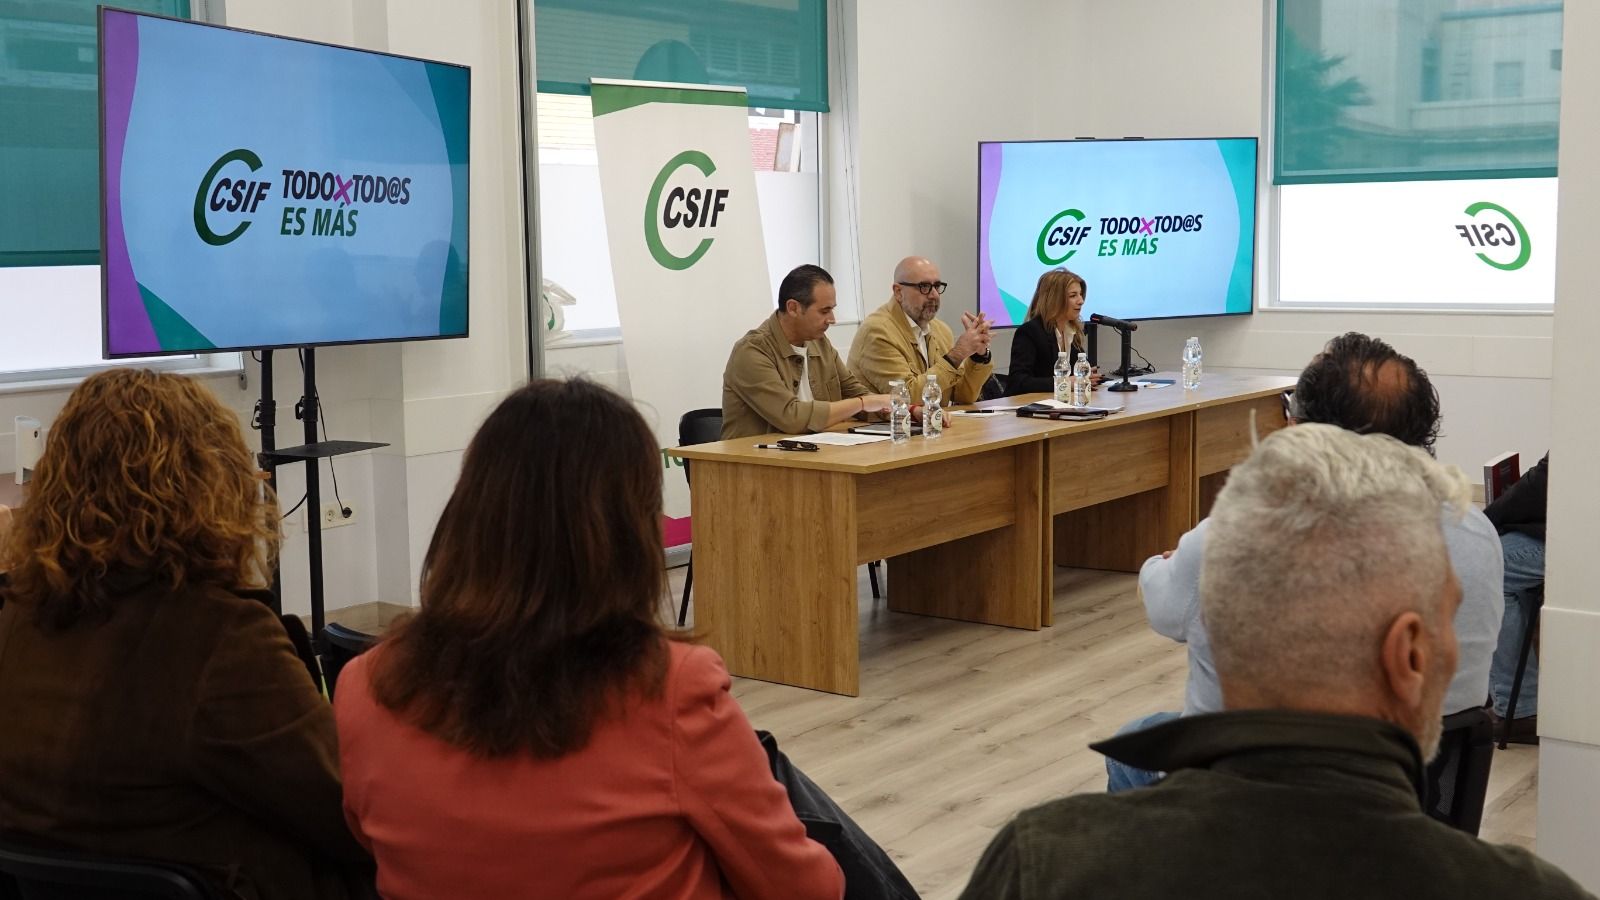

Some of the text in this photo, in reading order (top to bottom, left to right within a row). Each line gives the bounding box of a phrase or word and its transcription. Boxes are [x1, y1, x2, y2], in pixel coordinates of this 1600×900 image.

[210, 178, 272, 213] CSIF
[663, 186, 730, 229] CSIF
[280, 202, 359, 237] ES MÁS
[1047, 226, 1092, 247] CSIF
[1098, 234, 1159, 257] ES MÁS
